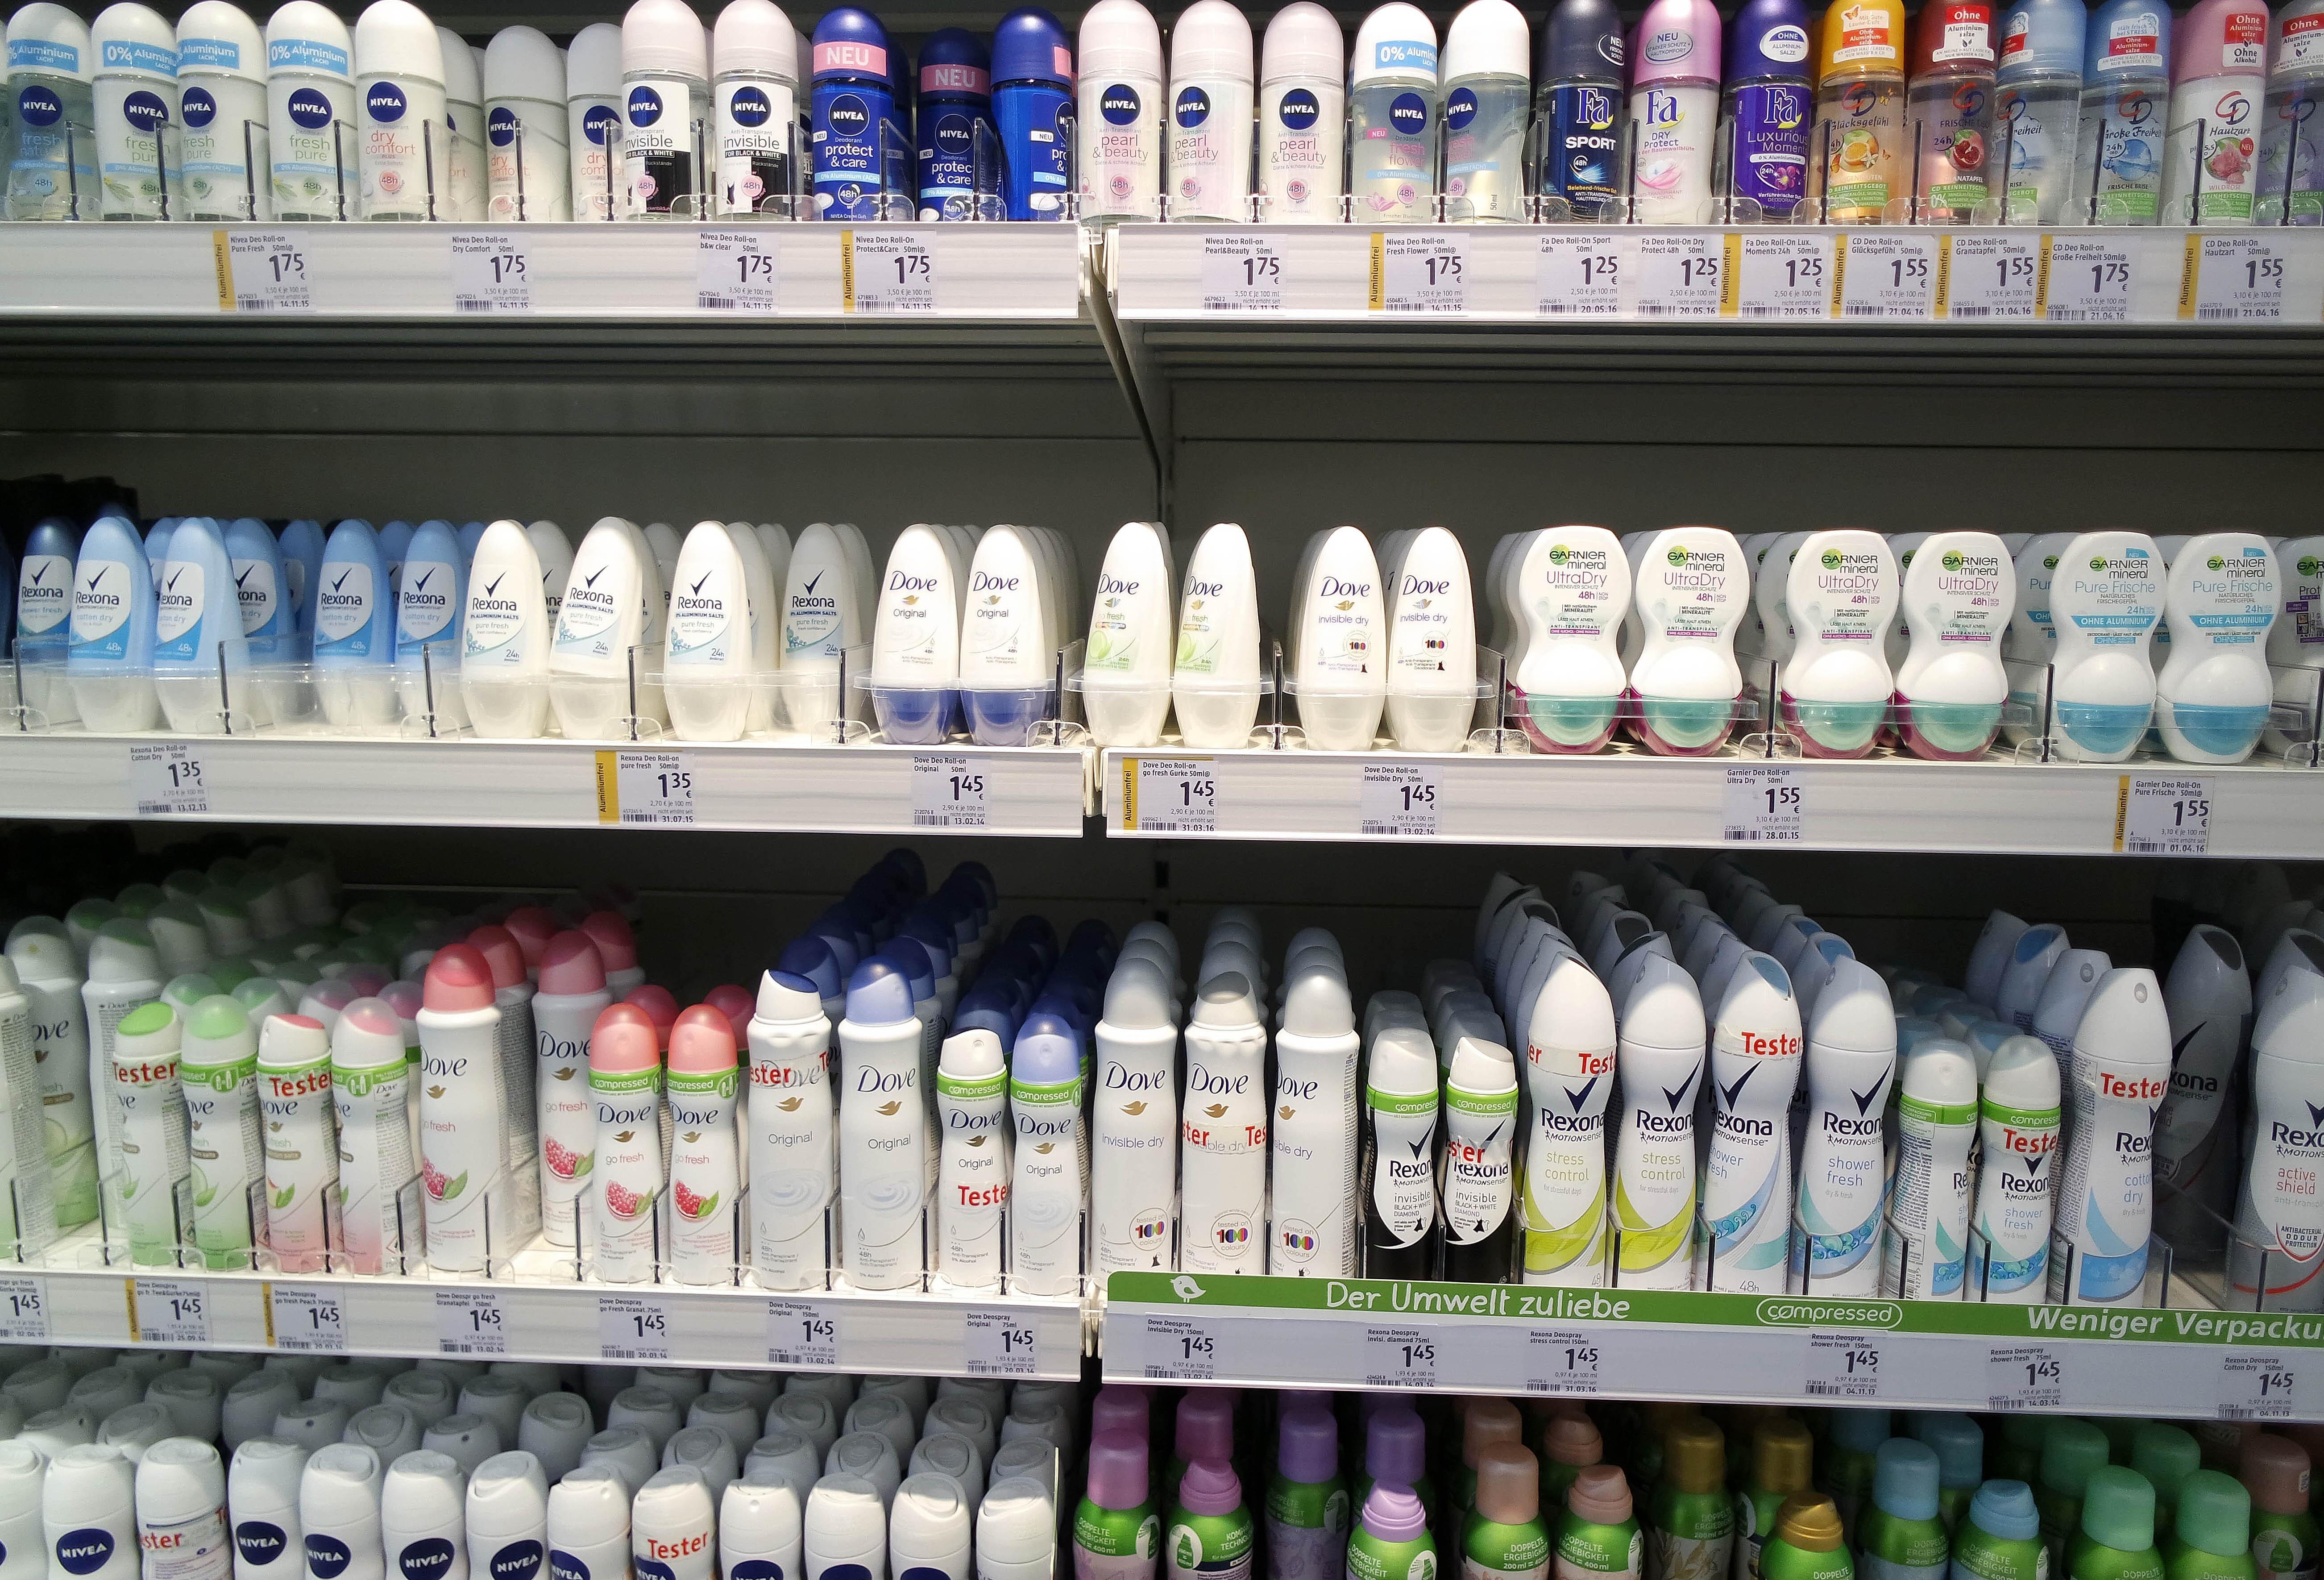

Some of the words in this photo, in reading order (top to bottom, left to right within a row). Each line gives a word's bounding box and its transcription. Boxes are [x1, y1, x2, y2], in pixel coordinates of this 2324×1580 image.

[1954, 12, 1980, 20] Ohne
[2236, 15, 2260, 24] Ohne
[1657, 33, 1678, 42] NEU
[270, 46, 290, 60] 0%
[292, 46, 346, 65] Aluminium
[826, 47, 869, 66] NEU
[292, 104, 328, 115] NIVEA
[735, 103, 766, 112] NIVEA
[1284, 105, 1315, 115] NIVEA
[1576, 88, 1610, 124] Fa
[1646, 89, 1679, 126] Fa
[1764, 88, 1798, 125] Fa
[833, 112, 865, 121] NIVEA
[1652, 132, 1671, 140] DRY
[2209, 127, 2250, 136] Hautzart
[289, 135, 331, 150] fresh
[724, 136, 780, 149] invisible
[1279, 139, 1316, 153] pearl
[1565, 136, 1616, 151] SPORT
[1644, 139, 1678, 148] Protect
[295, 150, 327, 162] pure
[825, 144, 873, 158] protect
[831, 158, 839, 167] &
[841, 158, 867, 168] care
[1272, 152, 1280, 162] &
[1282, 152, 1326, 165] beauty
[1225, 237, 1239, 245] Deo
[1241, 237, 1263, 245] Roll-on
[1593, 236, 1611, 245] Sport
[856, 245, 899, 254] Protect&Care
[1205, 247, 1249, 255] Pearl&Beauty
[1956, 247, 1996, 255] Granatapfel
[887, 288, 900, 296] 3,50
[906, 288, 911, 296] je
[1581, 306, 1617, 314] 20.05.16
[1996, 307, 2031, 316] 21.04.16
[1549, 550, 1606, 560] GARNIER
[1567, 560, 1606, 570] mineral
[2089, 559, 2148, 570] GARNIER
[1547, 571, 1607, 588] UltraDry
[2108, 568, 2148, 579] mineral
[889, 571, 937, 592] Dove
[1321, 577, 1370, 597] Dove
[2075, 581, 2108, 593] Pure
[2112, 581, 2155, 593] Frische
[76, 592, 119, 605] Rexona
[1578, 591, 1595, 600] 48h
[473, 597, 517, 611] Rexona
[893, 608, 926, 619] Original
[1319, 615, 1352, 624] invisible
[1355, 615, 1369, 626] dry
[2081, 616, 2104, 625] OHNE
[915, 765, 939, 773] Original
[1744, 778, 1755, 786] Dry
[663, 815, 693, 823] 31.07.15
[1765, 832, 1800, 840] 28.01.15
[1741, 1032, 1801, 1056] Tester
[1106, 1061, 1165, 1090] Dove
[595, 1077, 648, 1090] compressed
[2101, 1073, 2167, 1099] Tester
[1017, 1090, 1069, 1101] compressed
[599, 1103, 651, 1125] Dove
[606, 1154, 618, 1164] go
[620, 1152, 644, 1163] fresh
[1547, 1152, 1584, 1164] stress
[1828, 1157, 1875, 1170] shower
[1026, 1165, 1062, 1176] Original
[1545, 1168, 1589, 1181] control
[2278, 1168, 2316, 1181] active
[1827, 1171, 1863, 1186] fresh
[2276, 1179, 2316, 1195] shield
[1216, 1227, 1248, 1245] 100
[1327, 1282, 1381, 1309] Der
[1393, 1284, 1510, 1314] Umwelt
[1519, 1292, 1631, 1318] zuliebe
[1767, 1305, 1891, 1322] compressed
[967, 1321, 991, 1329] Original
[2028, 1307, 2162, 1335] Weniger
[2176, 1313, 2324, 1342] Verpacku
[648, 1532, 709, 1559] Tester
[1565, 1533, 1603, 1553] DOPPELTE
[62, 1544, 108, 1558] NIVEA
[1559, 1538, 1610, 1562] ERGIEBIGKEIT
[497, 1555, 538, 1573] NIVEA
